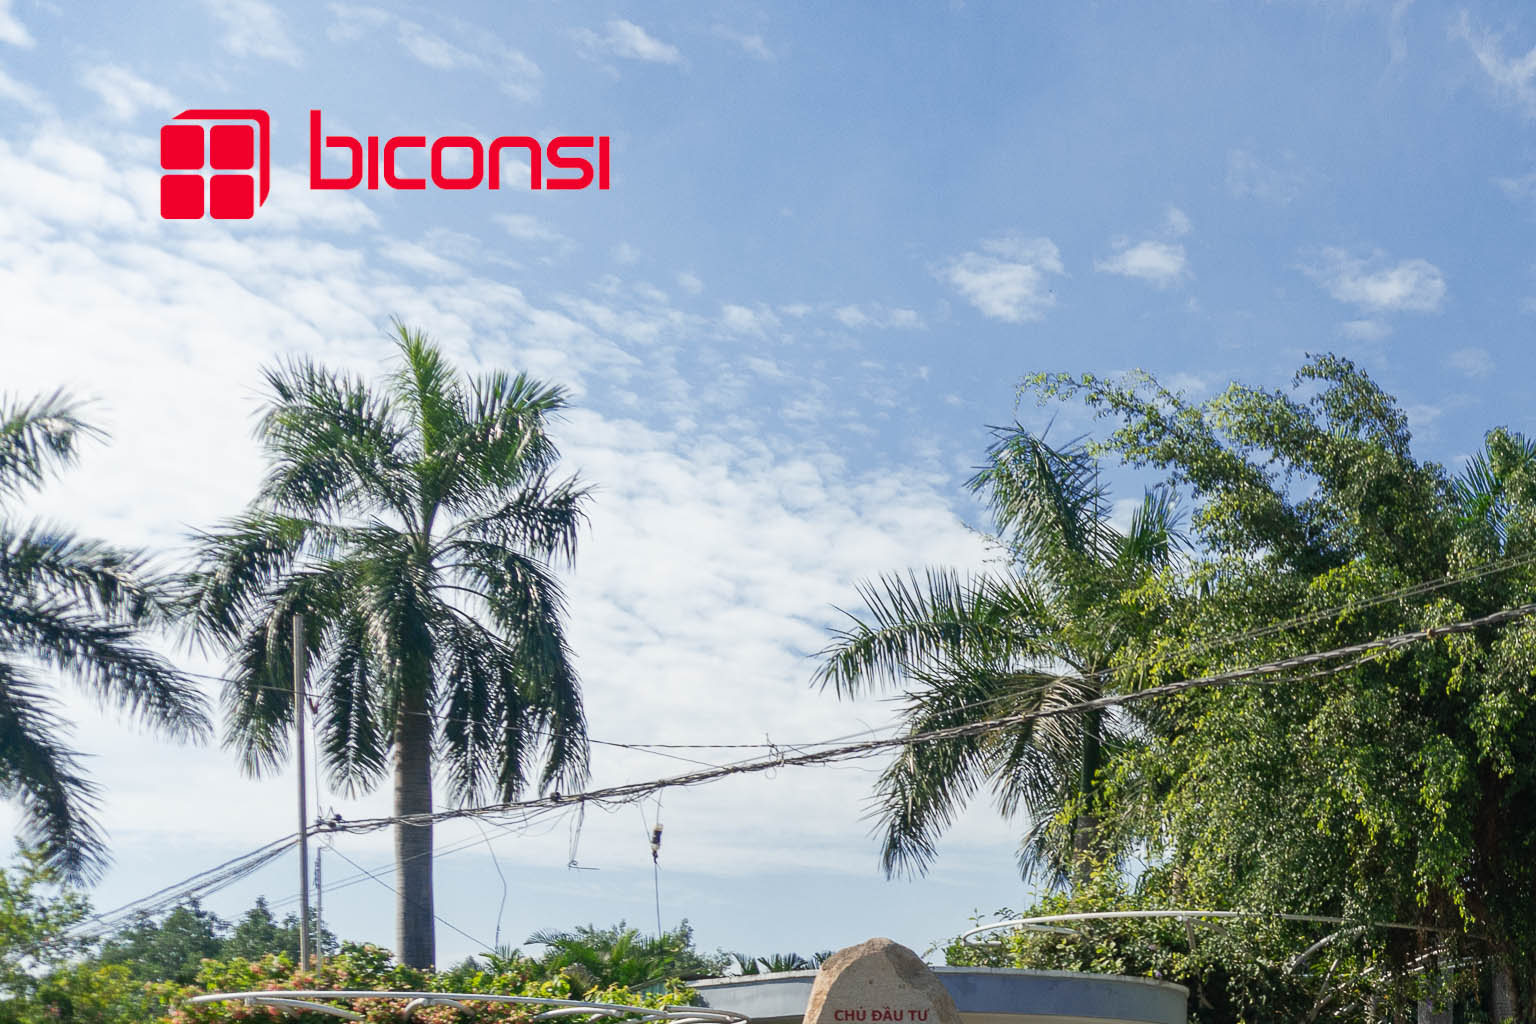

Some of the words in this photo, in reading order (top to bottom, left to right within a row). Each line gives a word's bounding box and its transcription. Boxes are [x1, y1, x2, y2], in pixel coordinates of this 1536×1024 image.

[834, 1006, 867, 1021] CHỦ
[871, 1006, 904, 1021] ĐẦU
[908, 1008, 930, 1021] TƯ
